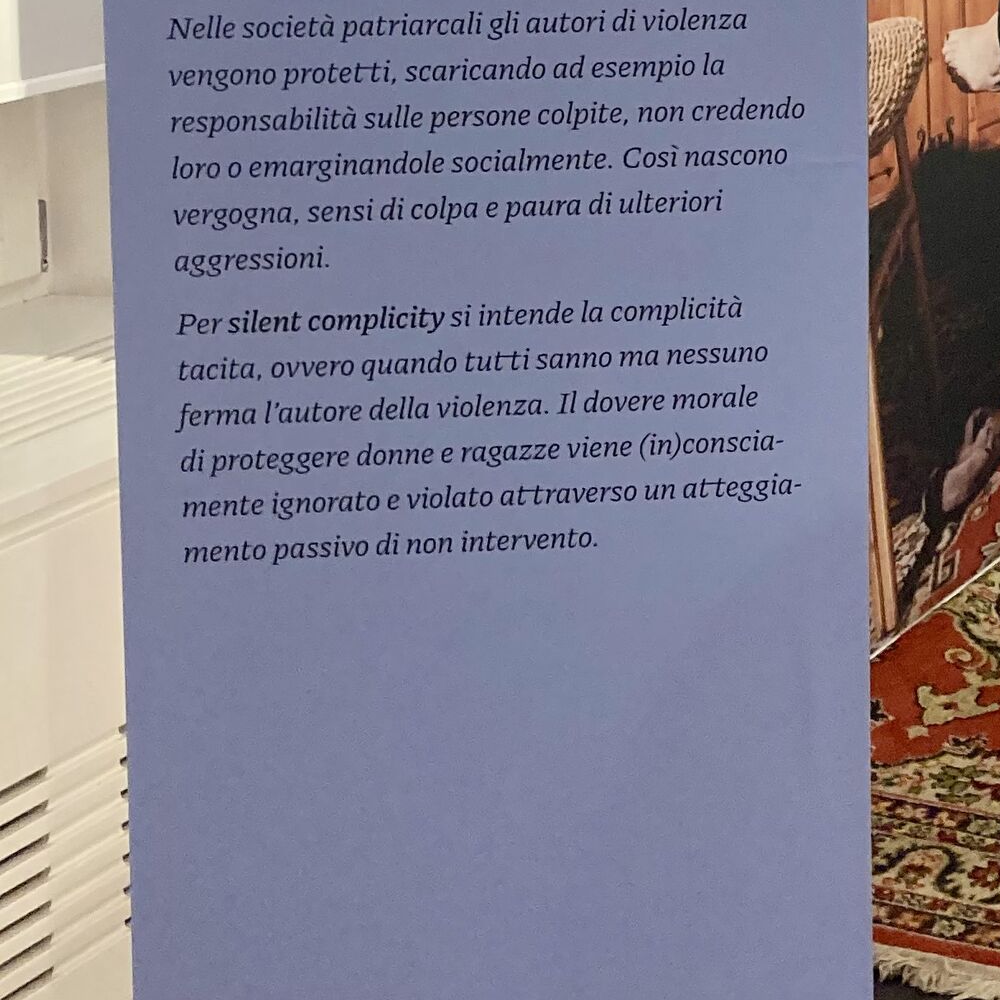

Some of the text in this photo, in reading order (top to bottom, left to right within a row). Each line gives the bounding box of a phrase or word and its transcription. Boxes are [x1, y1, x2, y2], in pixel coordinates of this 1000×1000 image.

[165, 6, 748, 44] Nelle società patriarcali gli autori di violenza
[168, 51, 725, 93] vengono protetti, scaricando ad esempio la
[170, 95, 806, 139] responsabilità sulle persone colpite, non credendo
